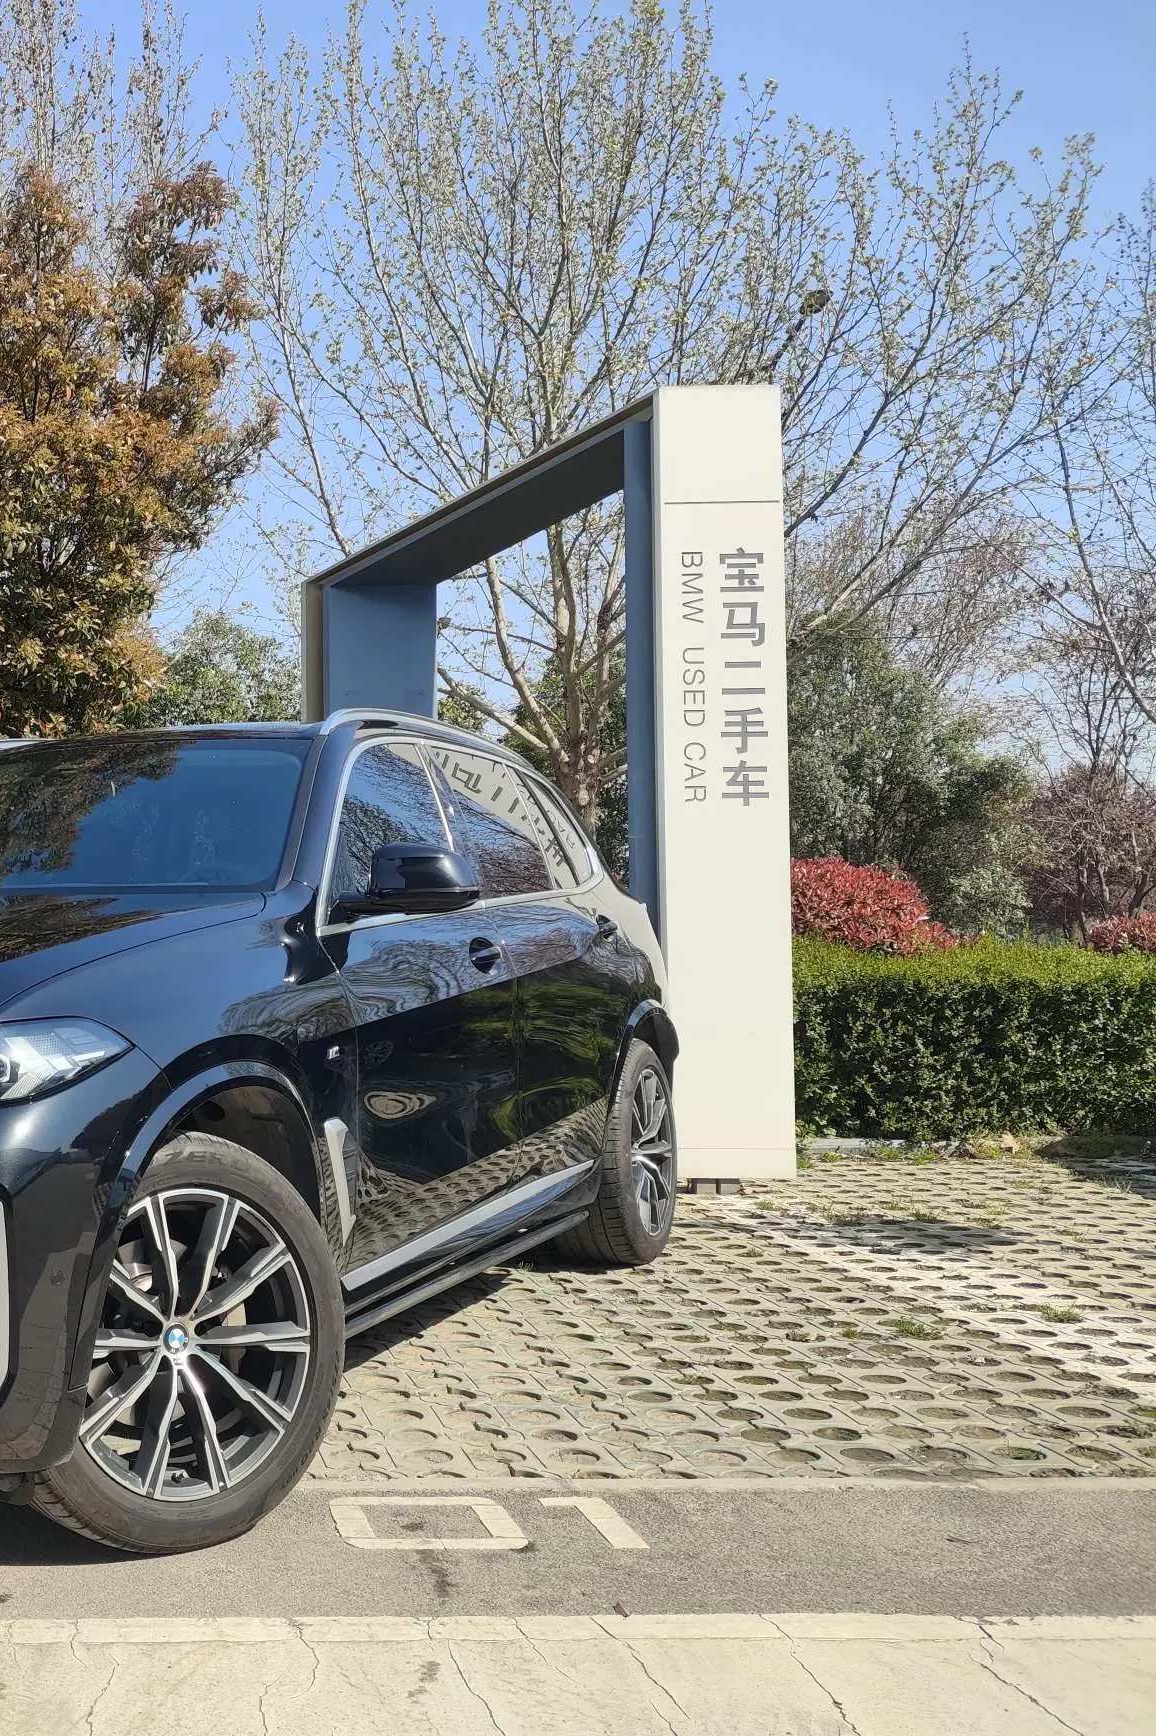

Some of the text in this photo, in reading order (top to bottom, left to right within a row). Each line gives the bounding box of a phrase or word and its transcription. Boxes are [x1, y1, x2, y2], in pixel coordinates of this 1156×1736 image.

[681, 551, 707, 803] BMW USED CAR
[719, 547, 770, 807] 宝马二手车
[329, 1496, 650, 1549] 01
